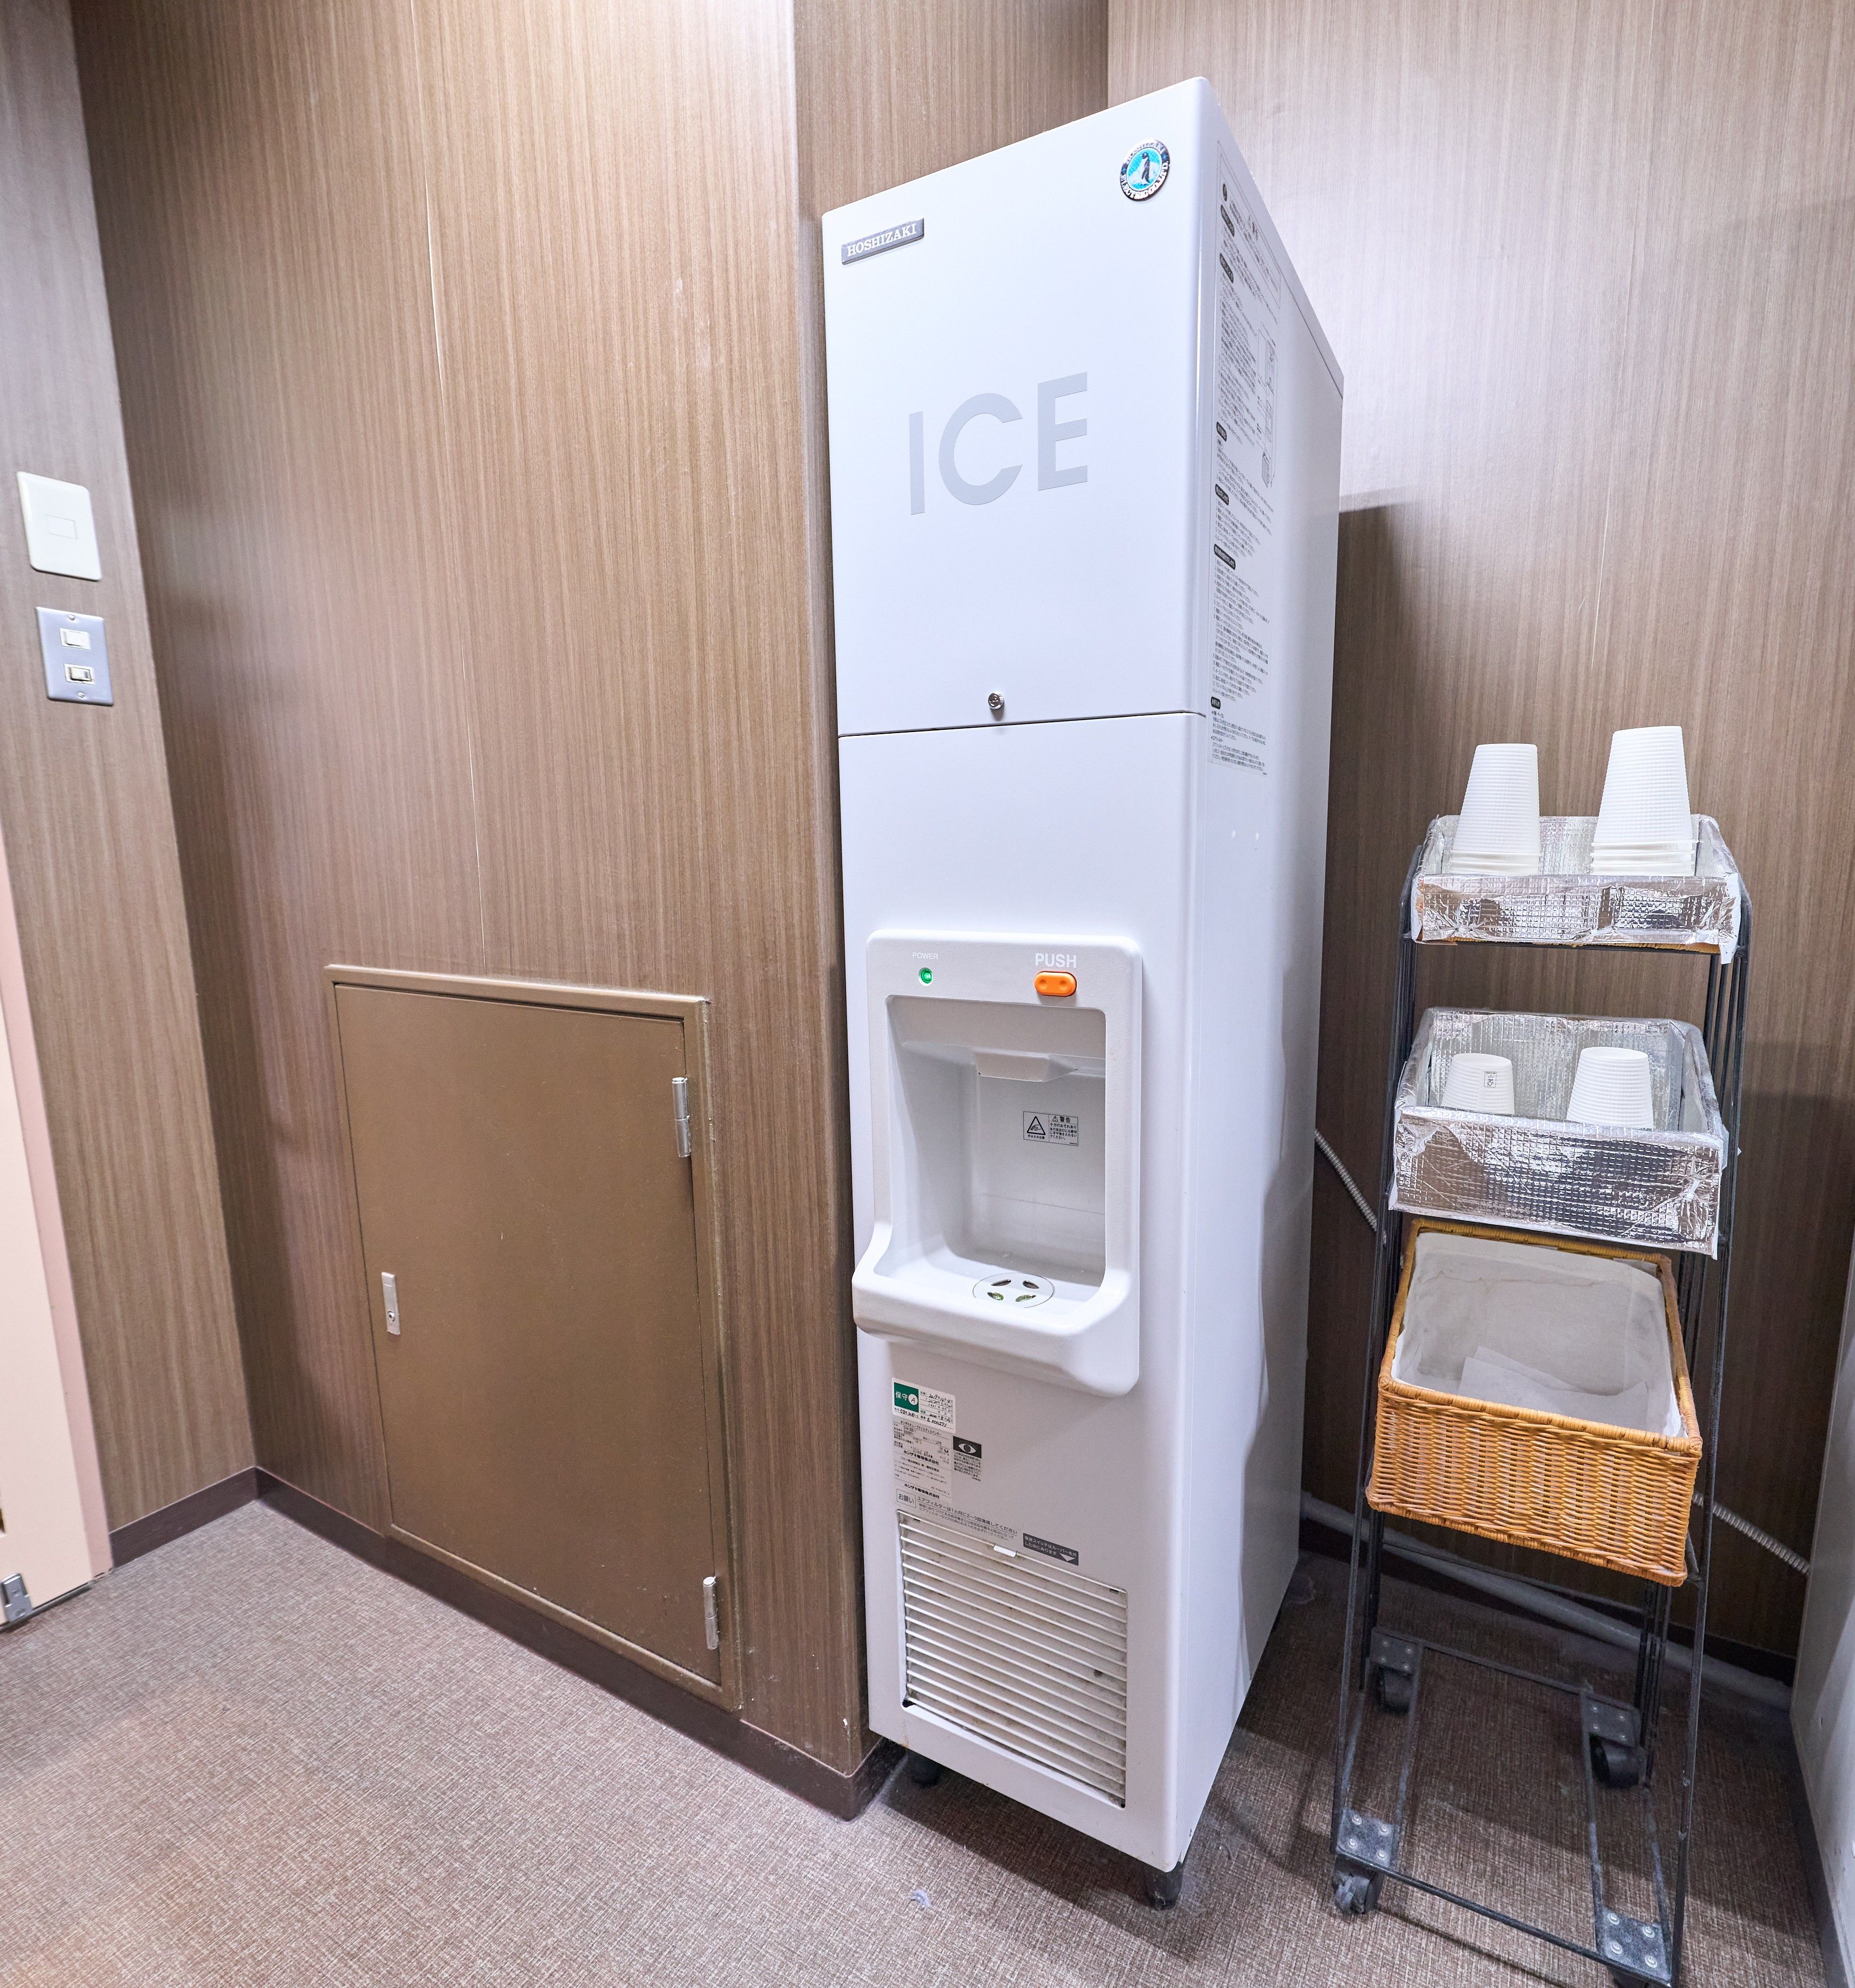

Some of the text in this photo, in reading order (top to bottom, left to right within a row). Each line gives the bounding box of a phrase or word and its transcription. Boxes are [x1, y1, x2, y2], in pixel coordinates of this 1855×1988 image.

[847, 223, 917, 257] HOSHIZAKI
[909, 371, 1088, 515] ICE
[912, 952, 938, 960] POWER
[1035, 953, 1077, 968] PUSH
[895, 1391, 908, 1401] 保守
[898, 1494, 914, 1503] お願い
